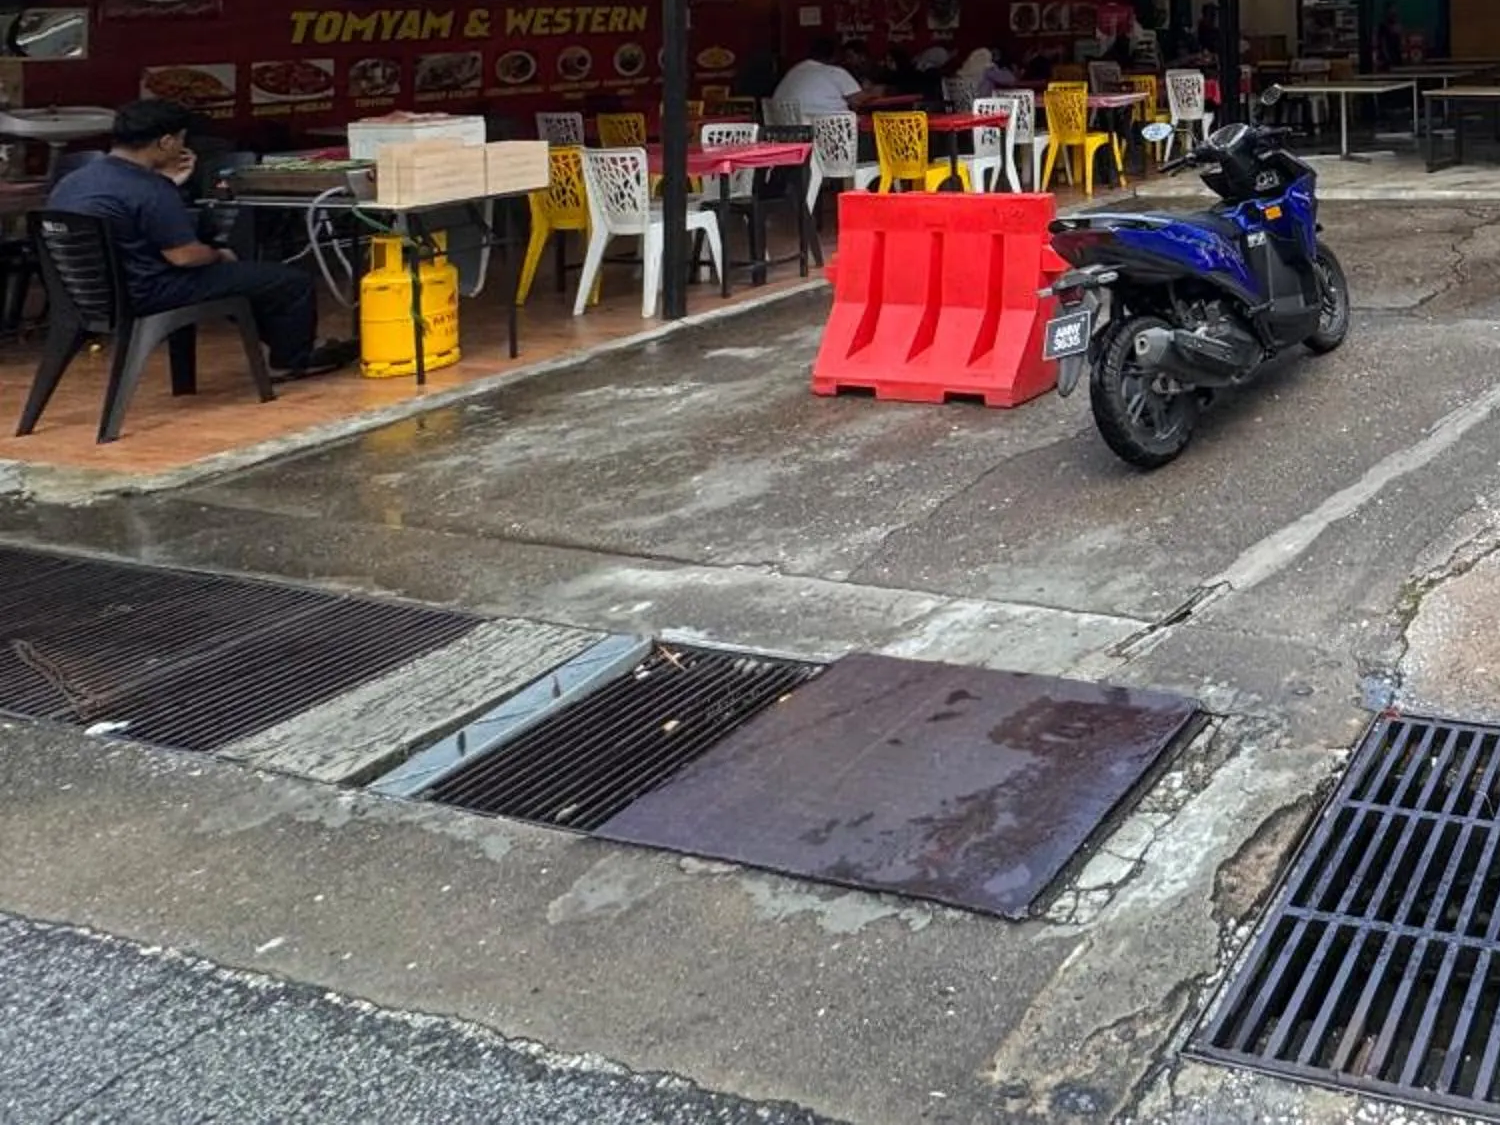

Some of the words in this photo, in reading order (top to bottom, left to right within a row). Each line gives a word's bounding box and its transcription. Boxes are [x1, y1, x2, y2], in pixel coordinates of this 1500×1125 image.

[290, 10, 454, 44] TOMYAM
[464, 8, 490, 38] &
[505, 6, 648, 36] WESTERN
